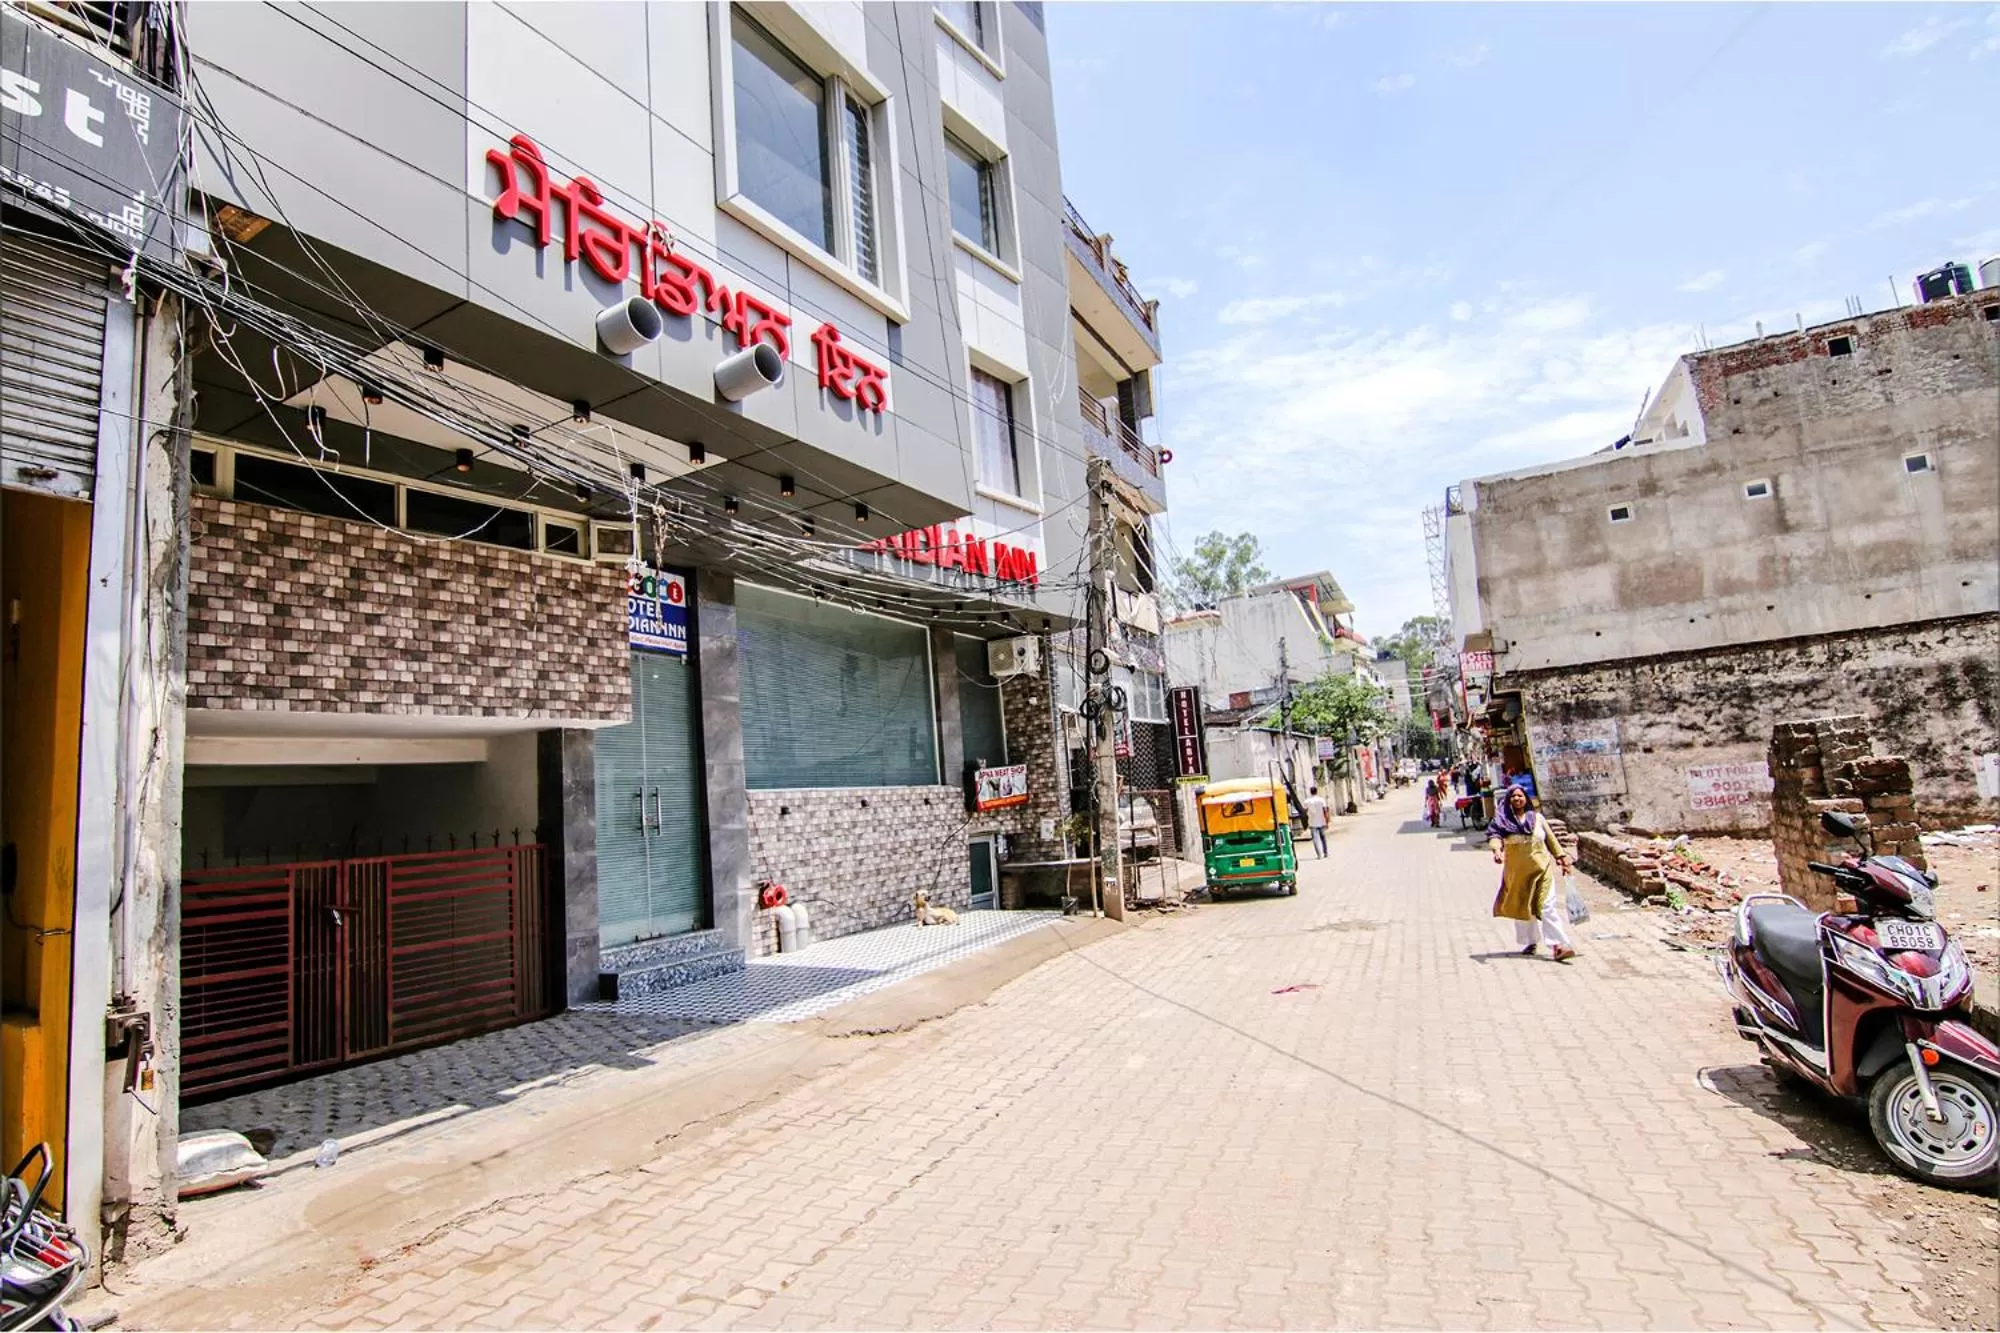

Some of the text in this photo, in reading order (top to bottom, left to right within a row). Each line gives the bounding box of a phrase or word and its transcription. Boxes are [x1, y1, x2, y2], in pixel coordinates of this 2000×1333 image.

[994, 542, 1038, 585] INN
[628, 598, 662, 618] OTE
[1181, 691, 1195, 774] HOTEL ARYA
[995, 768, 1009, 777] MEAT
[1011, 765, 1025, 774] SHOP
[1887, 924, 1931, 936] CH01C
